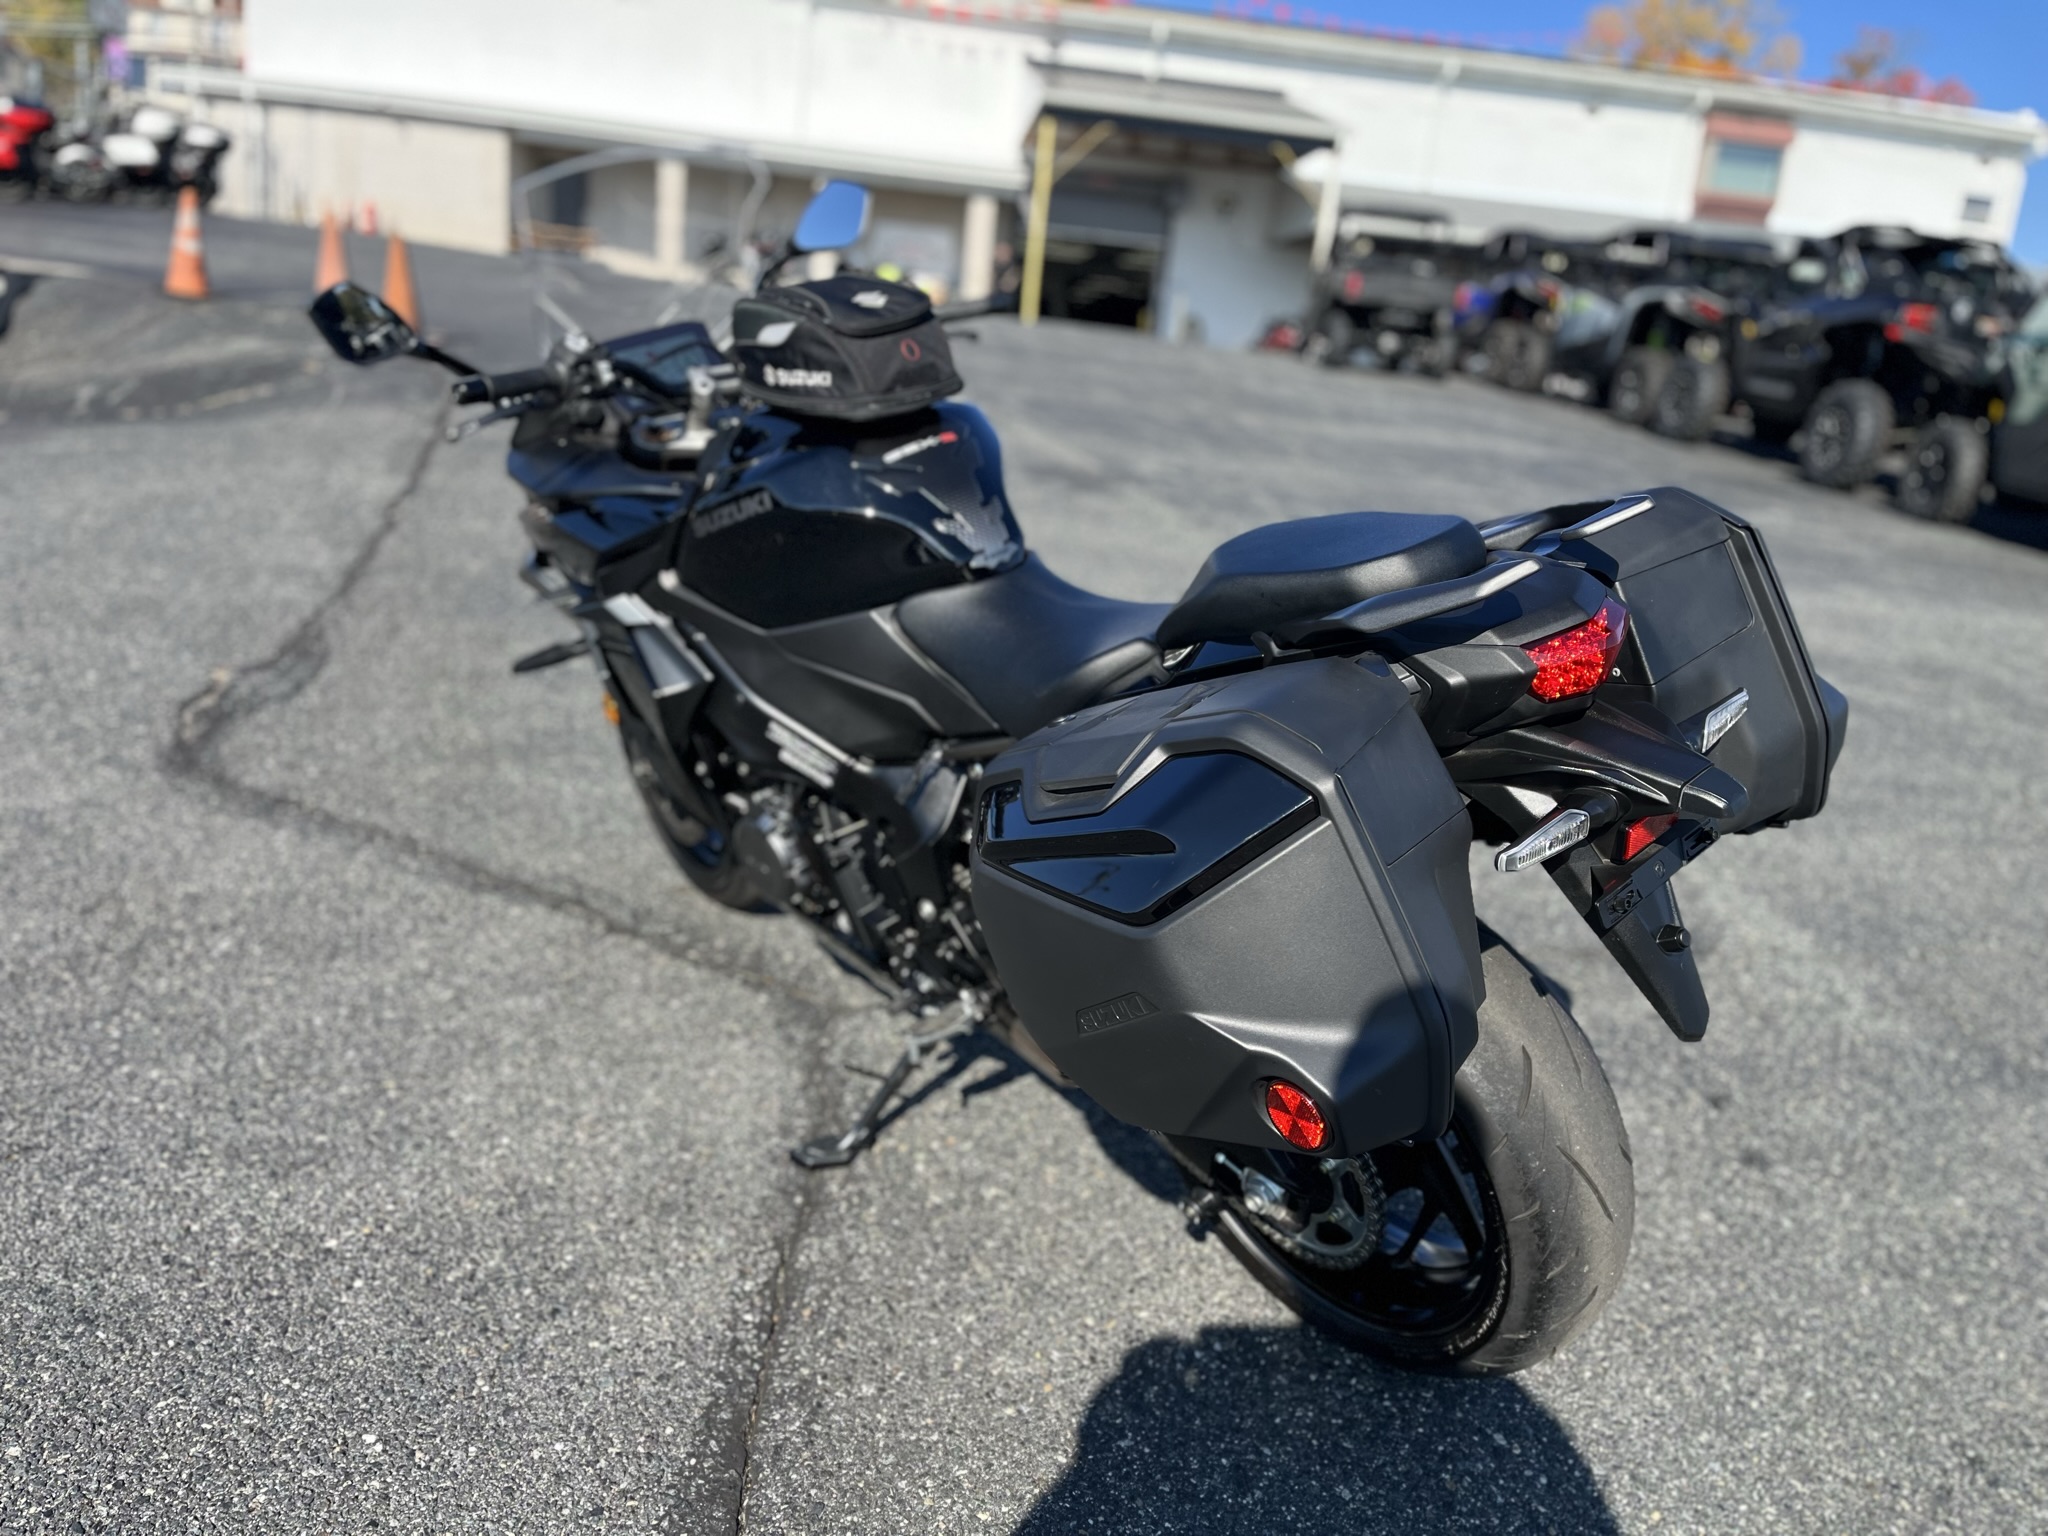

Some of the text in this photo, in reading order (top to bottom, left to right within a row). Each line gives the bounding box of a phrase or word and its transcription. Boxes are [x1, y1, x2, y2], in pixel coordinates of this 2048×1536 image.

[763, 364, 832, 387] SUZUKI
[693, 490, 773, 538] SUZUKI
[1080, 995, 1150, 1032] SUZUKI
